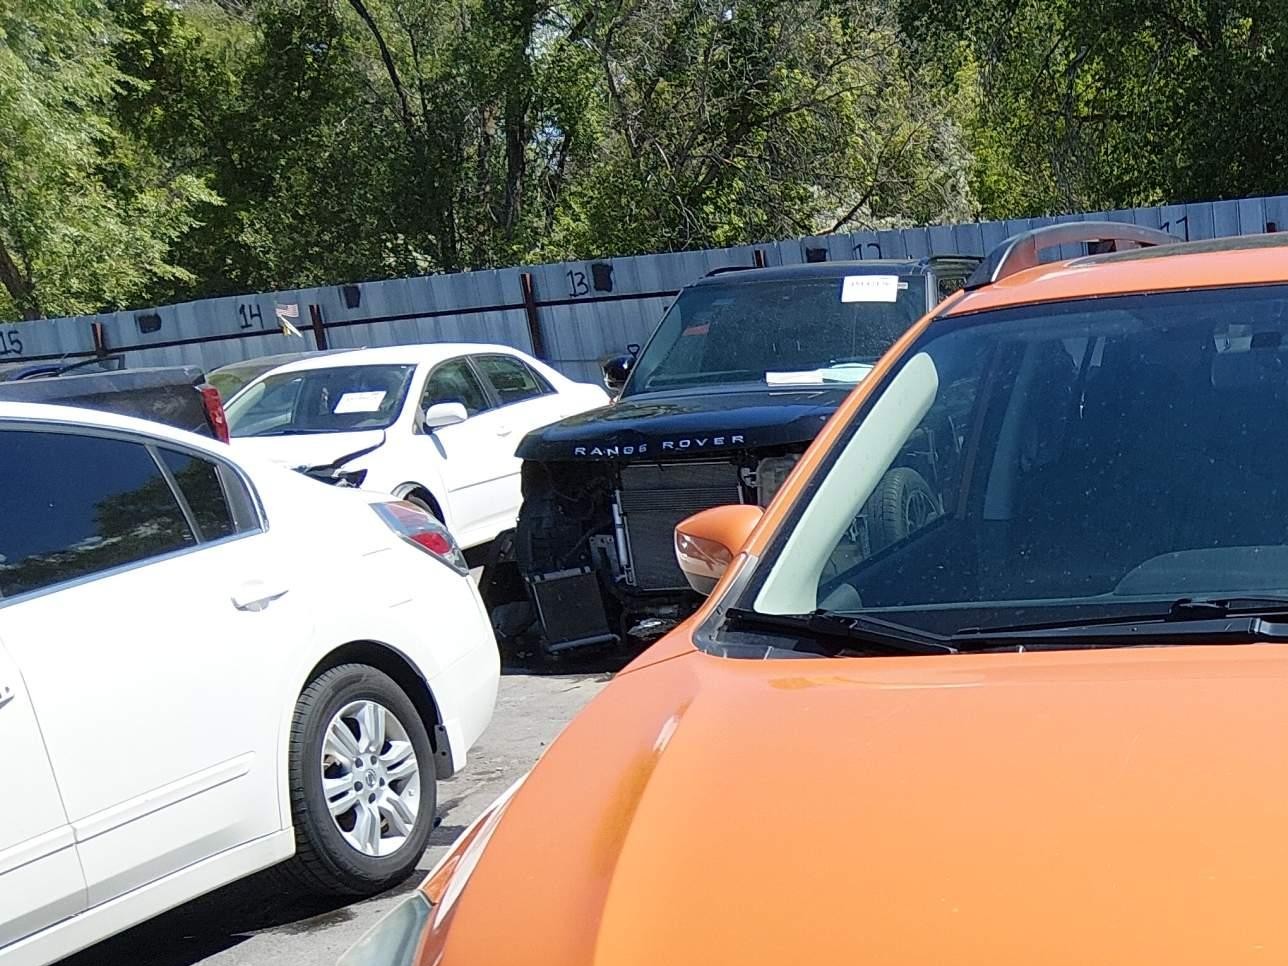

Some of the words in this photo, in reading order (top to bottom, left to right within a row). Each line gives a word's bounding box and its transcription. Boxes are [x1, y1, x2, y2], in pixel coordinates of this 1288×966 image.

[566, 269, 589, 297] 13
[239, 303, 264, 330] 14
[0, 329, 23, 355] 15
[574, 443, 648, 457] RANGE
[662, 435, 745, 450] ROVER
